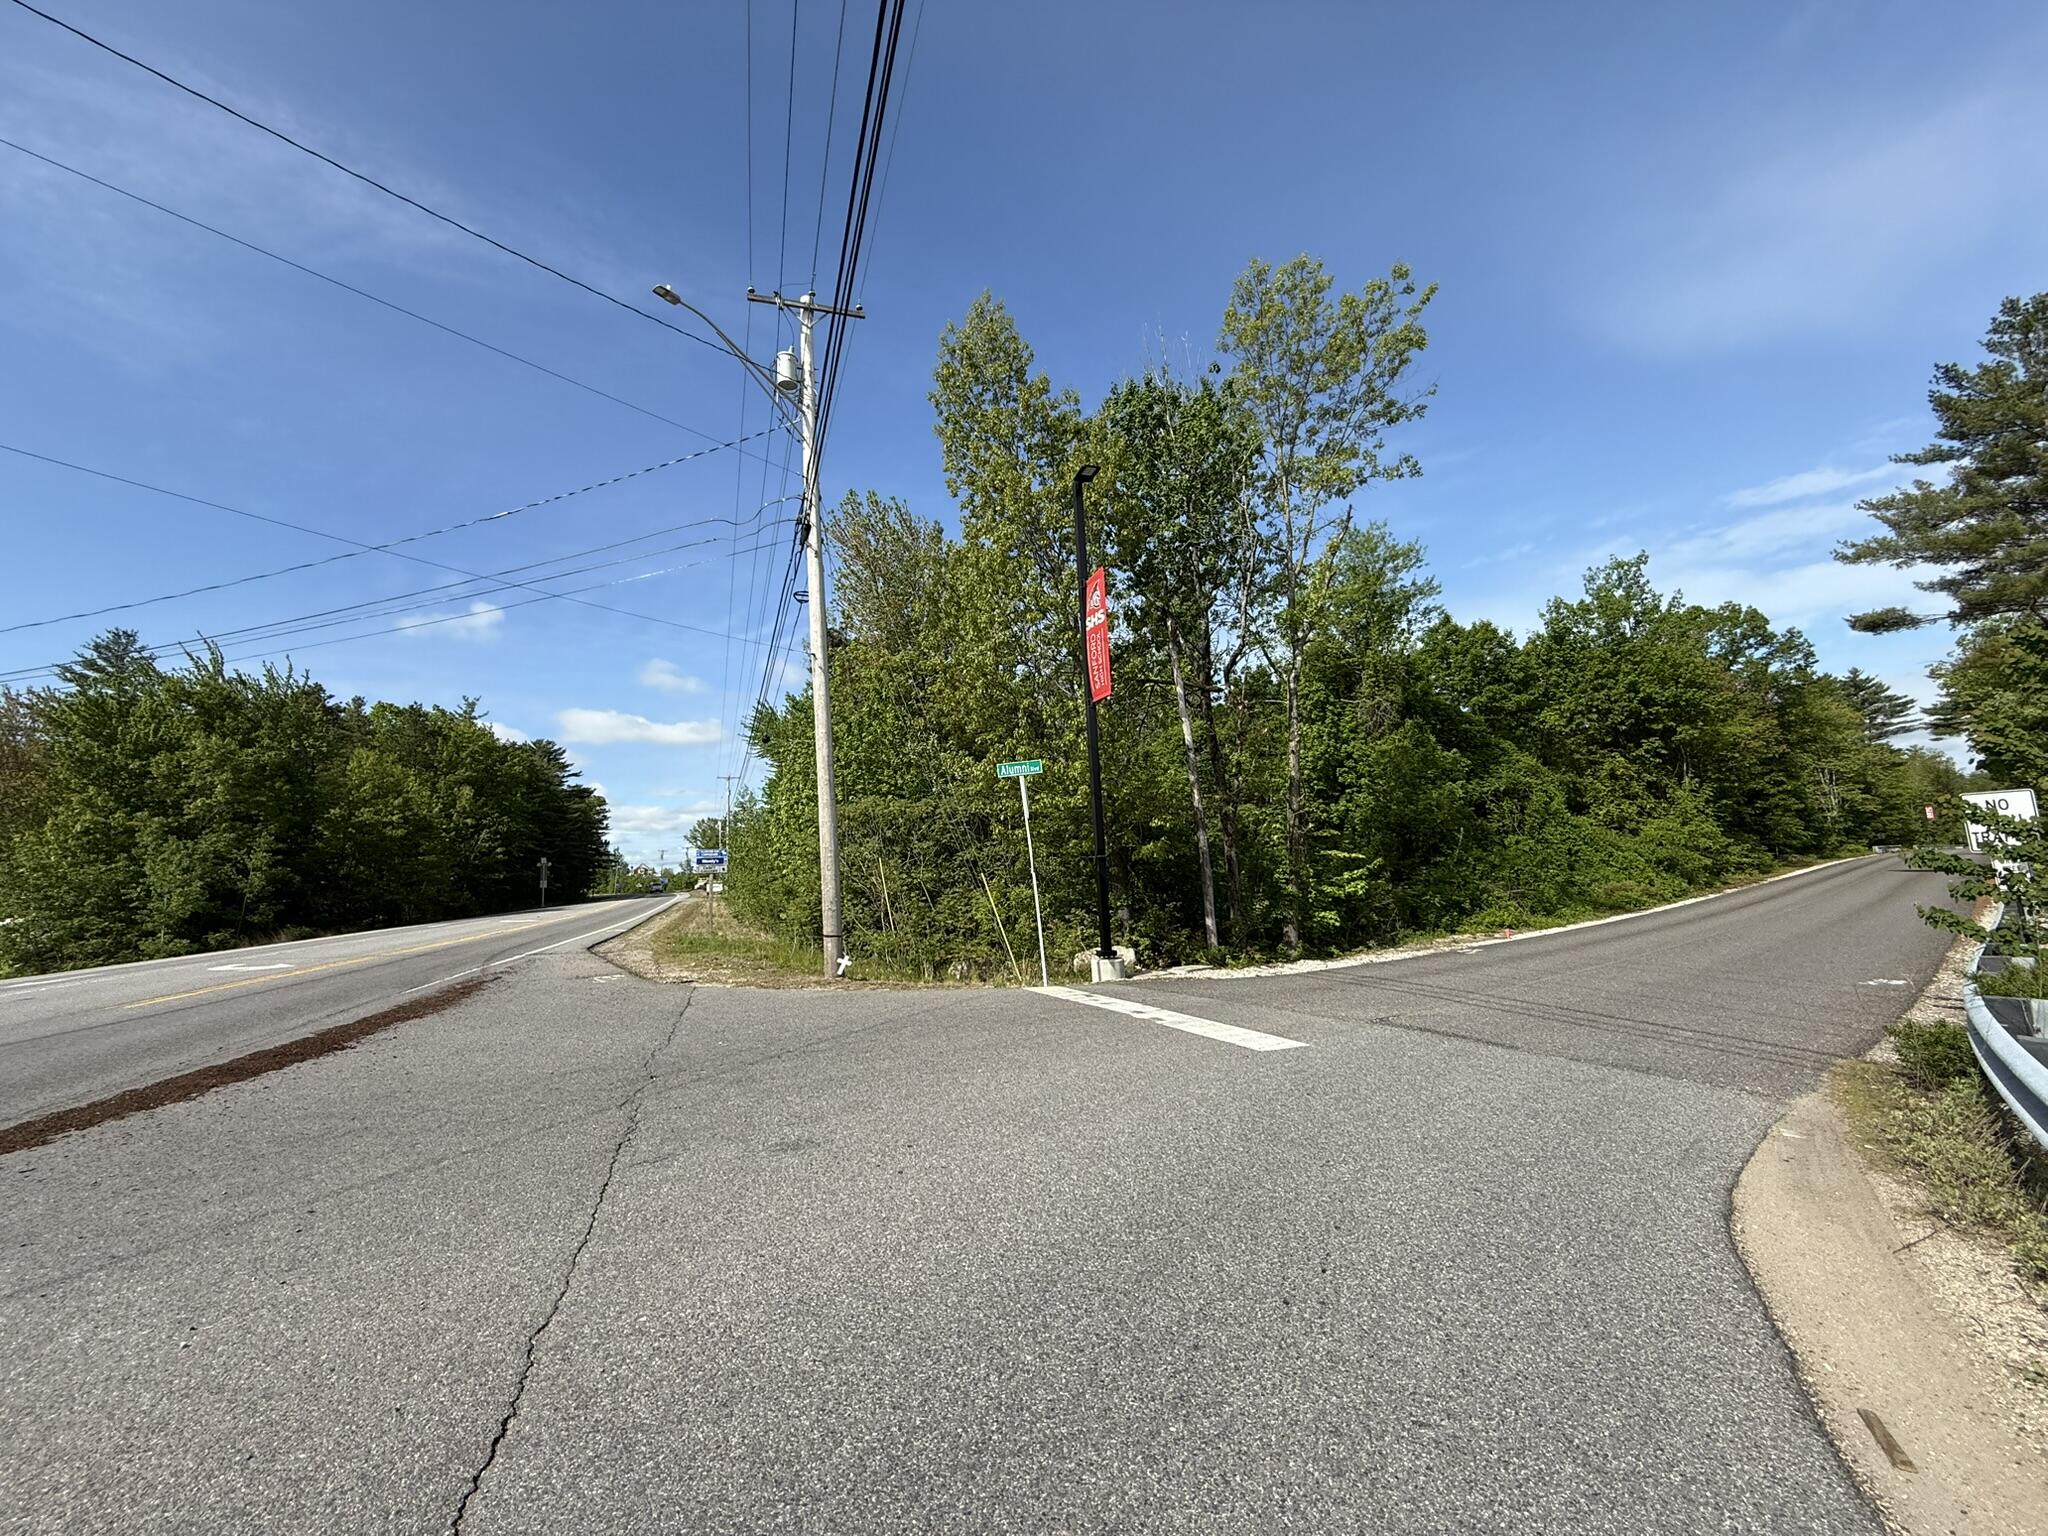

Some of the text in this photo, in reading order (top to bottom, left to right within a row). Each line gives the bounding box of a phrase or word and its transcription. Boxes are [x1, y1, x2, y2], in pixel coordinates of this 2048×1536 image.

[1086, 609, 1105, 631] SHS
[1090, 633, 1101, 689] SANFORD
[1001, 763, 1030, 775] Alumni
[1985, 799, 2009, 811] NO
